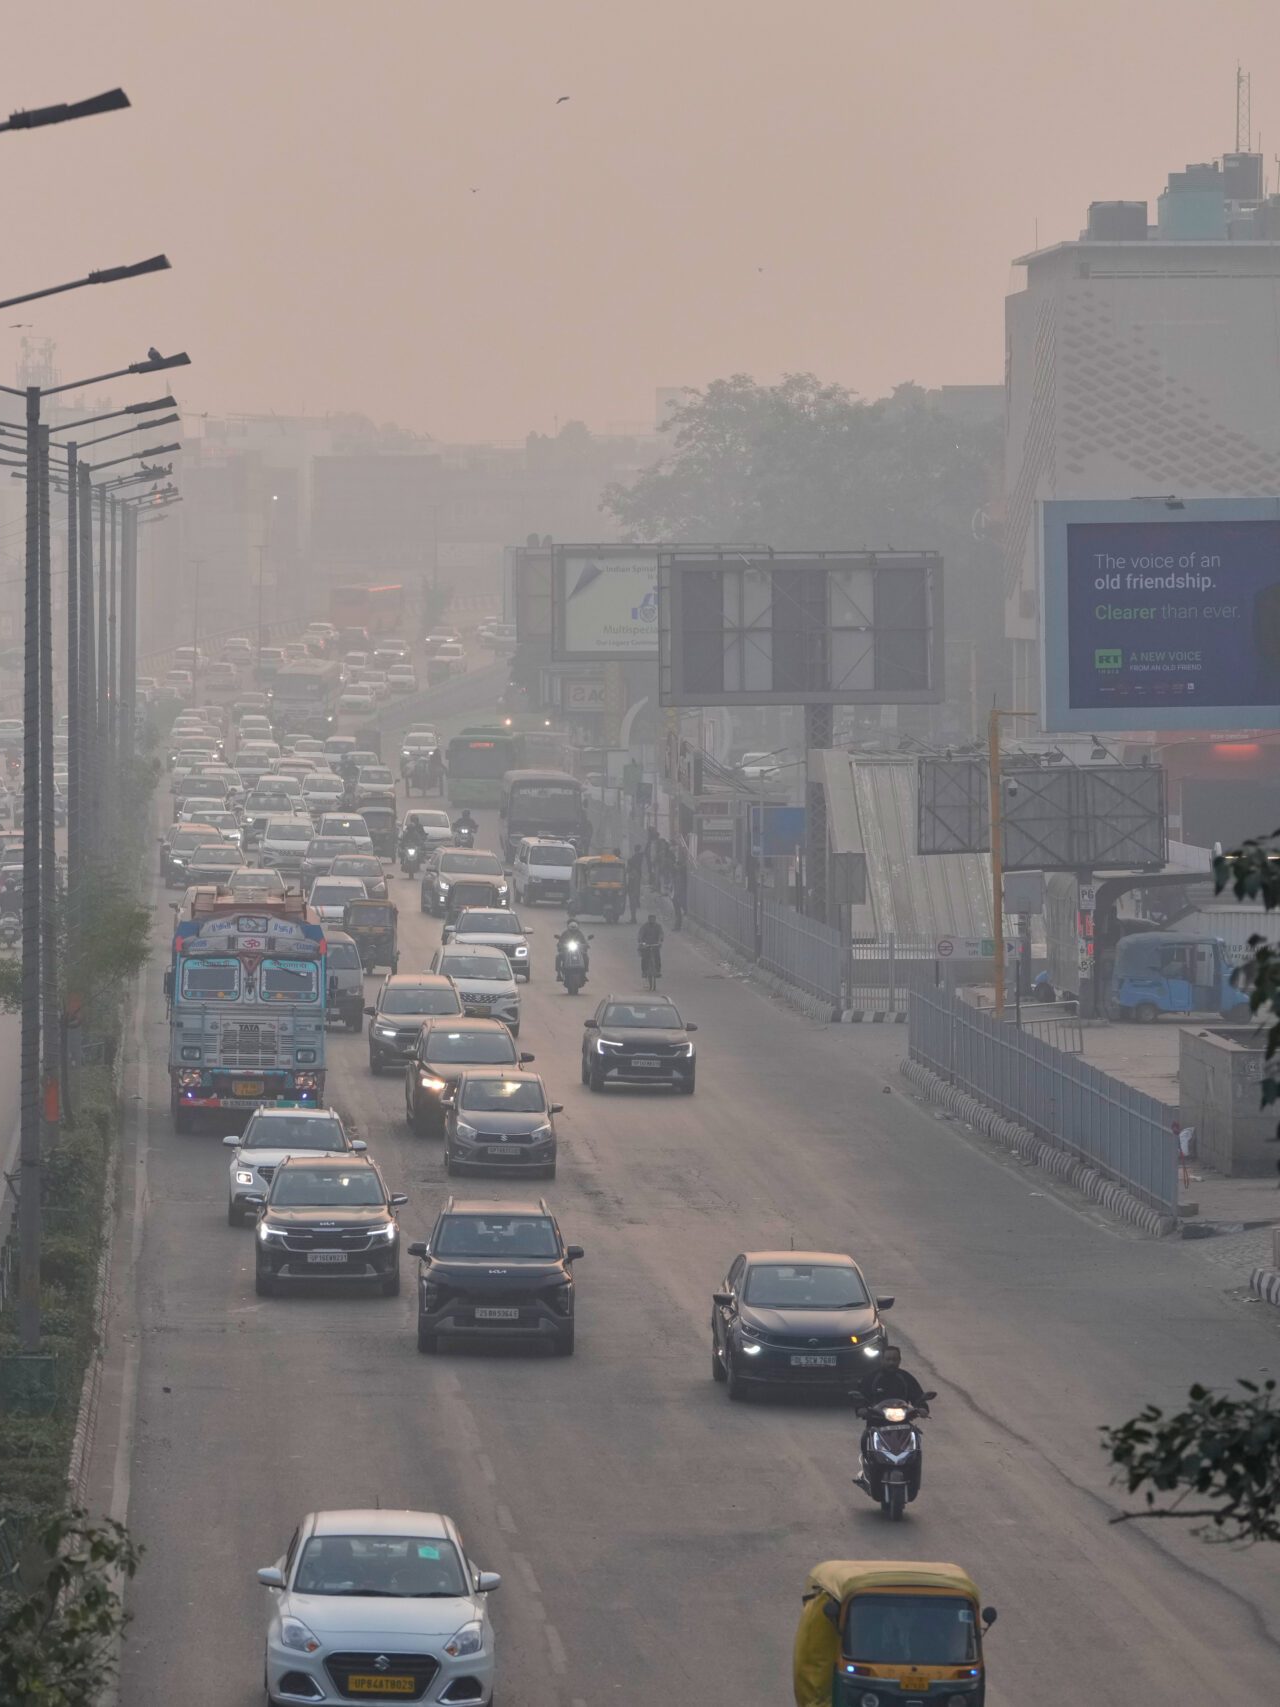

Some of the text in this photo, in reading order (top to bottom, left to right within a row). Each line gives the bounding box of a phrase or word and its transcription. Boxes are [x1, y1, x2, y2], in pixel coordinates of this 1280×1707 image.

[1093, 551, 1221, 569] The voice of an
[606, 565, 631, 573] Indian
[1094, 572, 1217, 592] old friendship.
[1094, 603, 1241, 620] Clearer than ever.
[1129, 652, 1138, 661] A
[1140, 652, 1166, 661] NEW
[1169, 651, 1202, 661] VOICE
[239, 1024, 260, 1032] TATA
